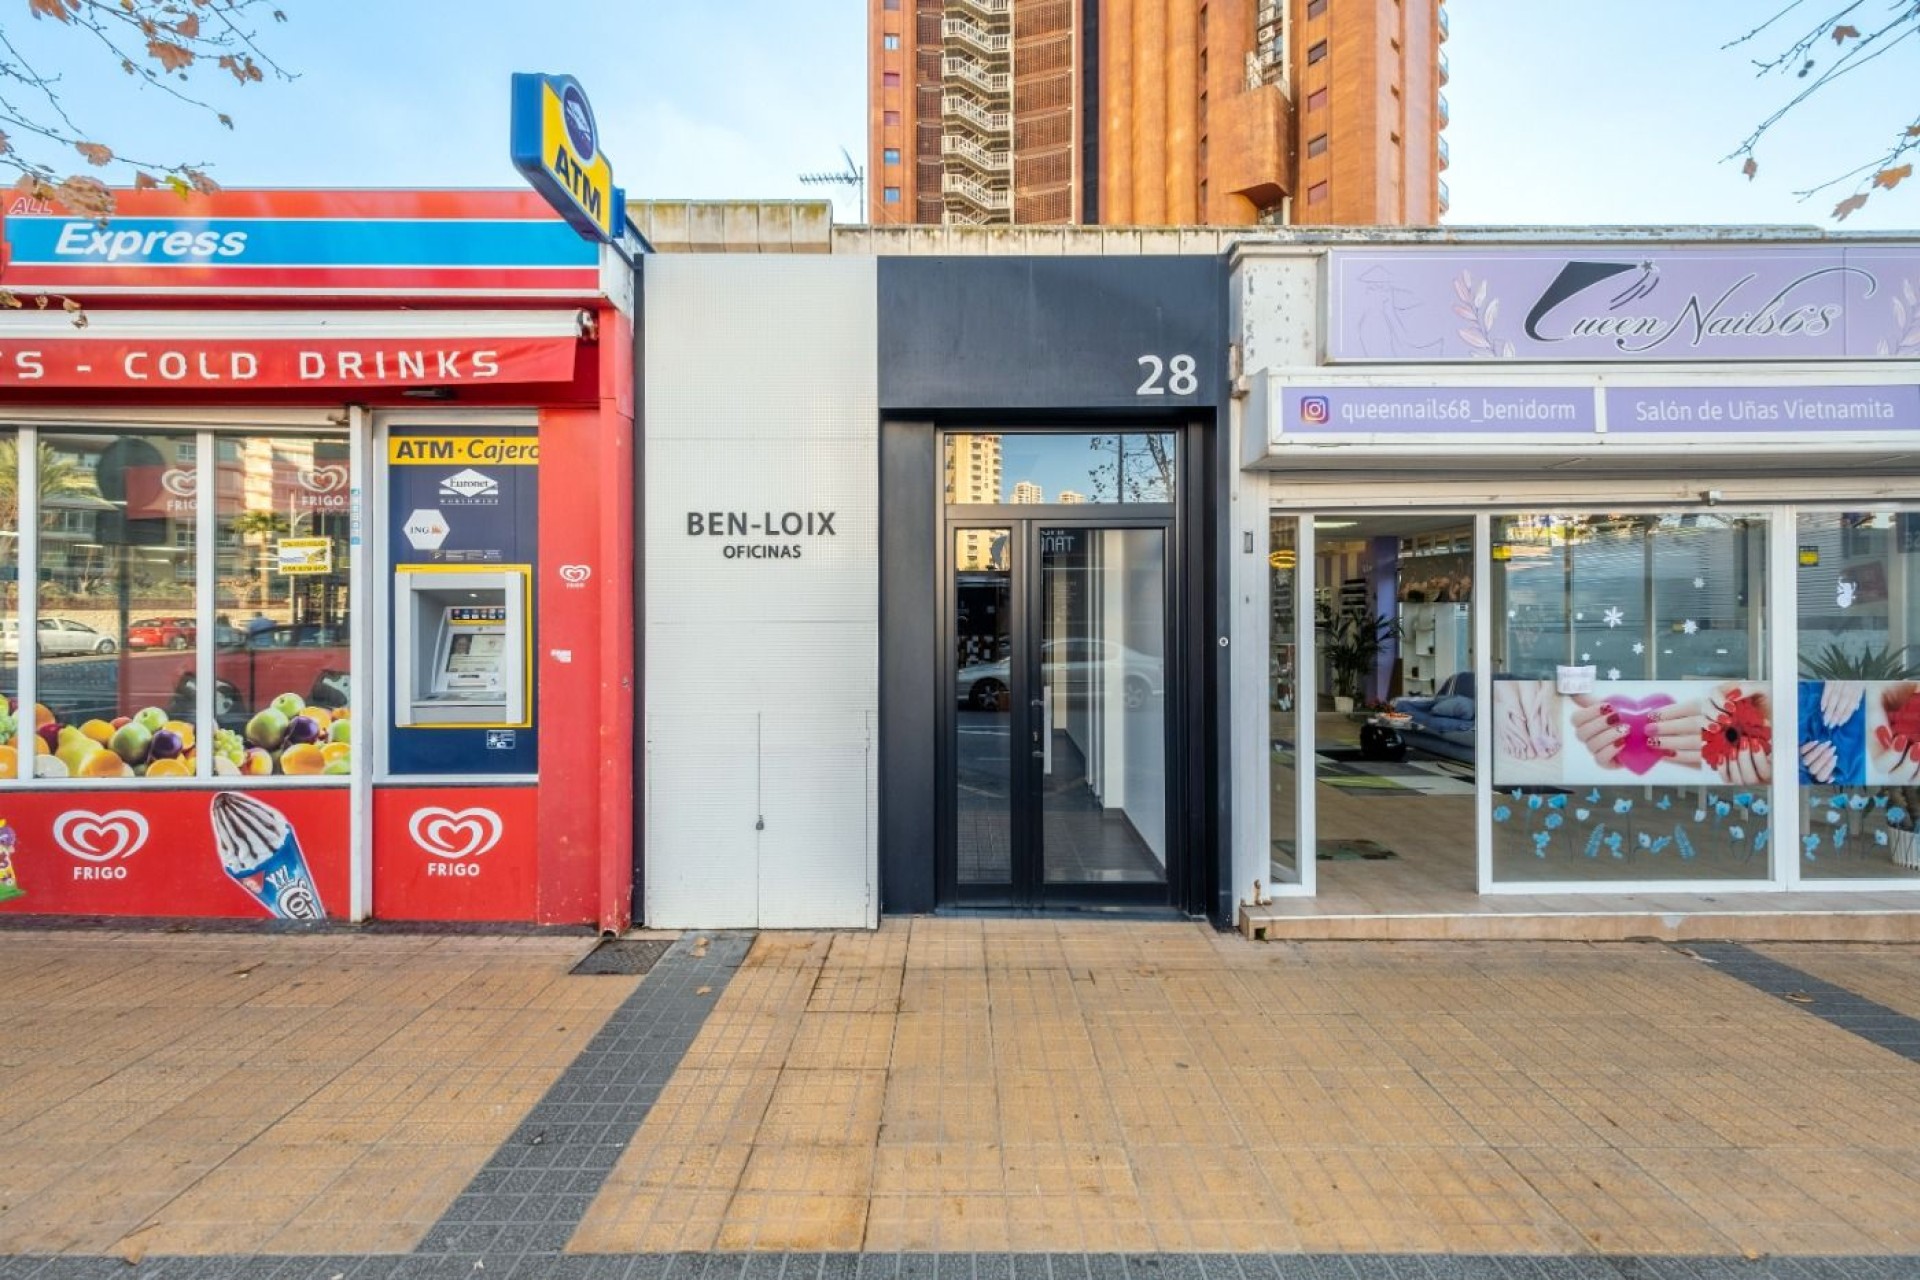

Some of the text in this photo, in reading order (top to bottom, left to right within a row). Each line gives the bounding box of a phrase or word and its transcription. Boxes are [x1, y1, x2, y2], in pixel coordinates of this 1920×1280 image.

[553, 143, 601, 221] ATM
[55, 222, 248, 261] Express
[124, 352, 258, 380] COLD
[300, 350, 499, 379] DRINKS
[1136, 354, 1199, 396] 28
[1341, 398, 1576, 424] queennails68_benidorm
[1635, 397, 1895, 421] Salón de Uñas Vietnamita
[396, 440, 454, 459] ATM
[450, 477, 489, 488] Euronet
[167, 501, 197, 512] FRIG
[302, 494, 344, 506] FRIGO
[410, 526, 429, 535] ING
[687, 512, 836, 536] BEN-LOIX
[722, 545, 802, 559] OFICINAS
[73, 866, 127, 880] FRIGO
[427, 862, 480, 877] FRIGO
